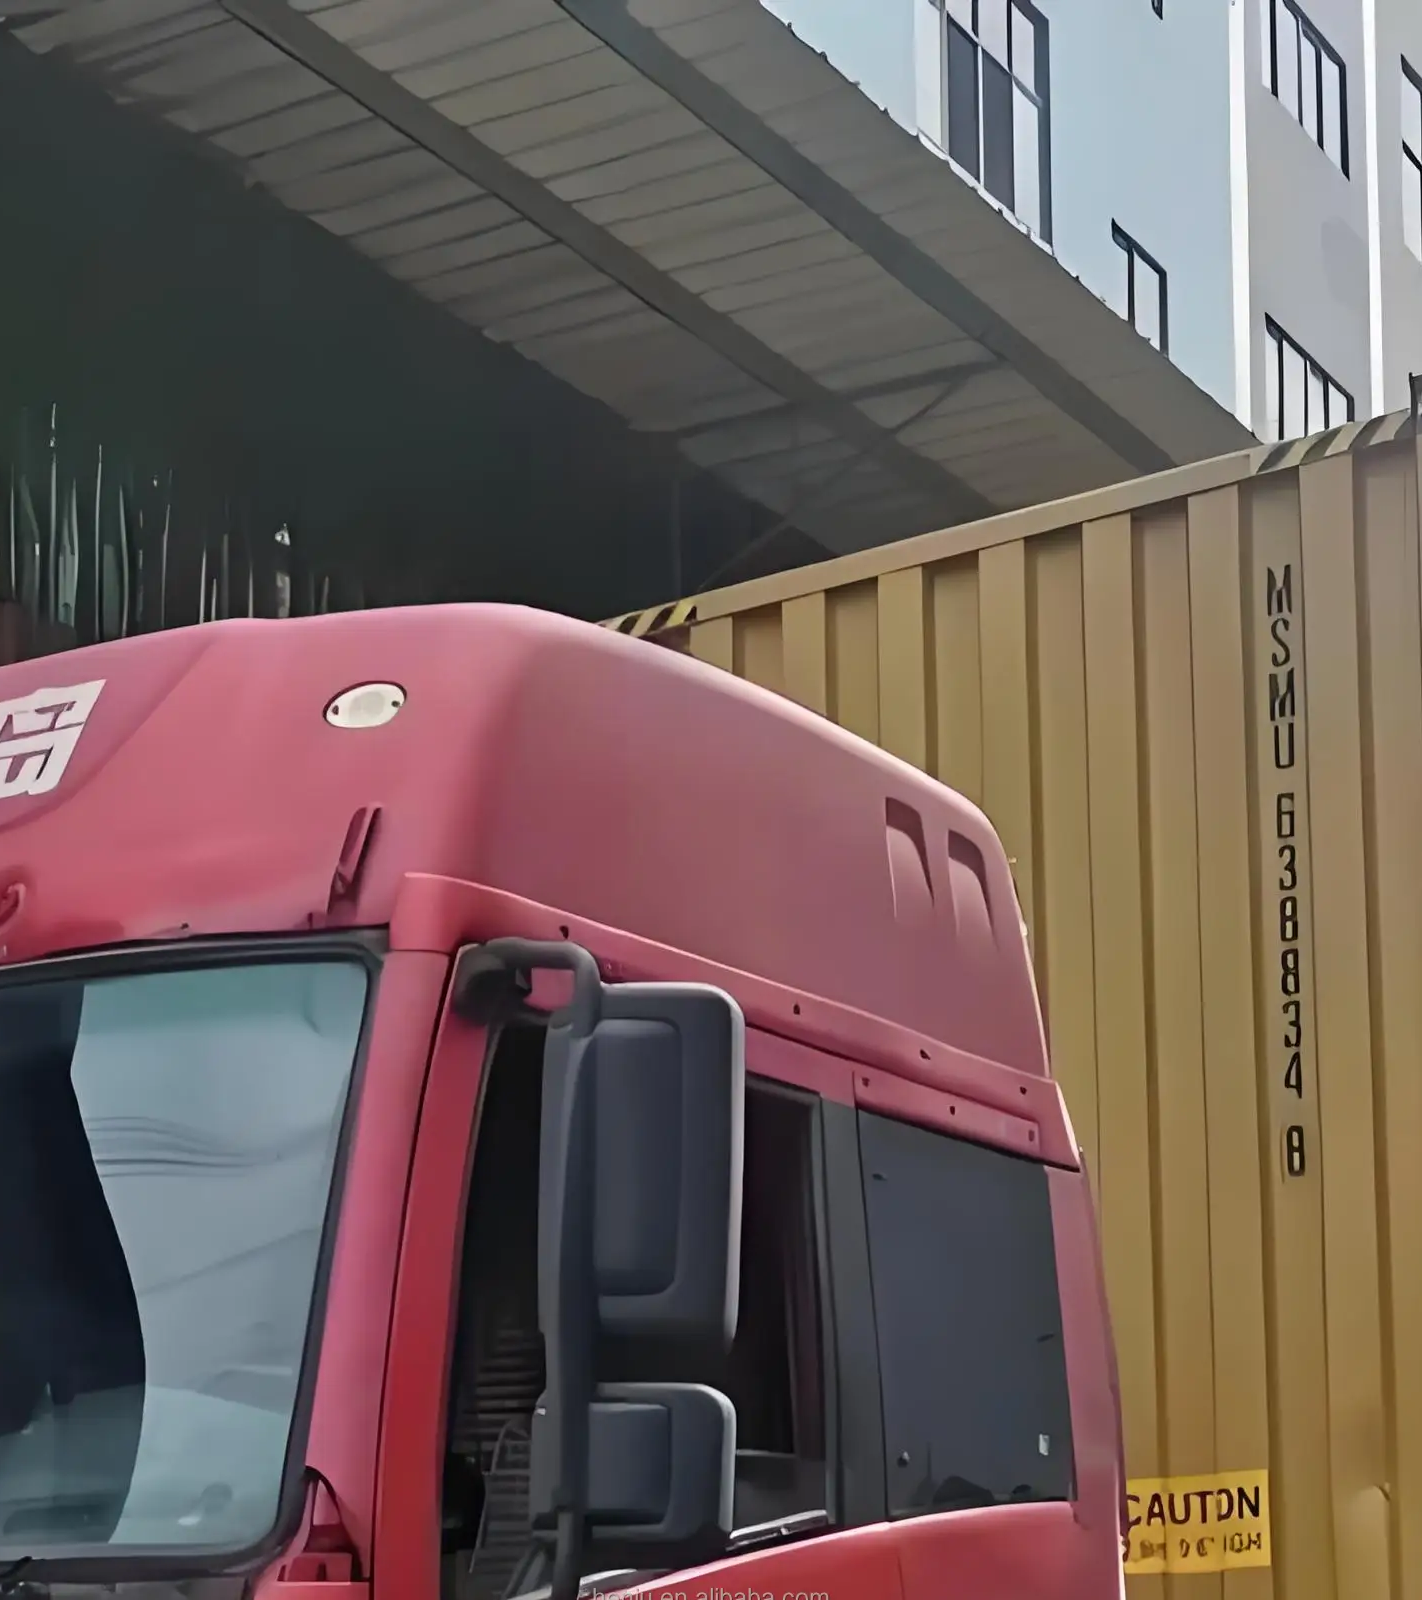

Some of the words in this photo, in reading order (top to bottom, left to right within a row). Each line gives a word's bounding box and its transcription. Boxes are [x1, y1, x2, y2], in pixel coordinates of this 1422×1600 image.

[1266, 564, 1296, 770] MSMU
[1277, 792, 1302, 1099] 638834
[1285, 1125, 1306, 1176] 8
